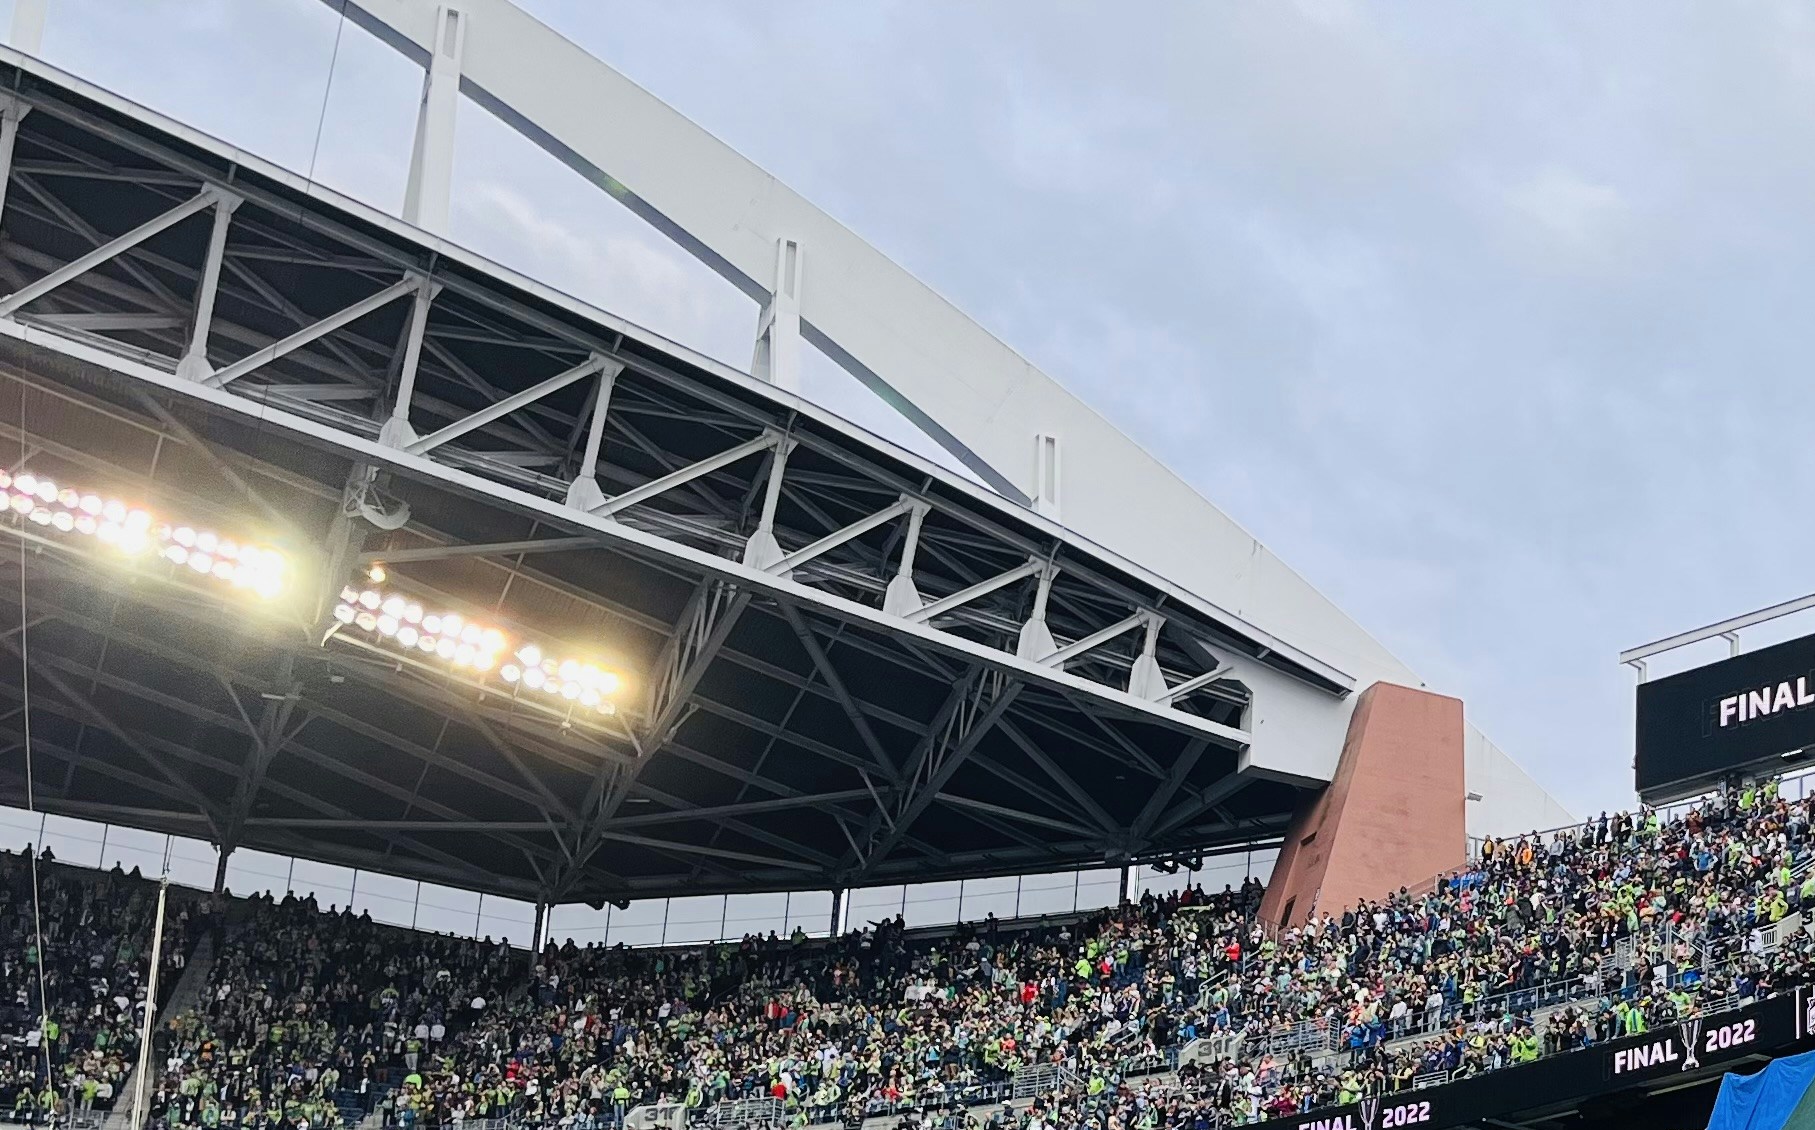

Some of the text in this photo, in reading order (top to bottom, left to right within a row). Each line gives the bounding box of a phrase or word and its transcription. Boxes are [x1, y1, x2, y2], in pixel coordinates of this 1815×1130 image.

[1720, 677, 1815, 727] FINAL
[1613, 1018, 1756, 1075] FINAL 2022
[1382, 1101, 1431, 1129] 2022
